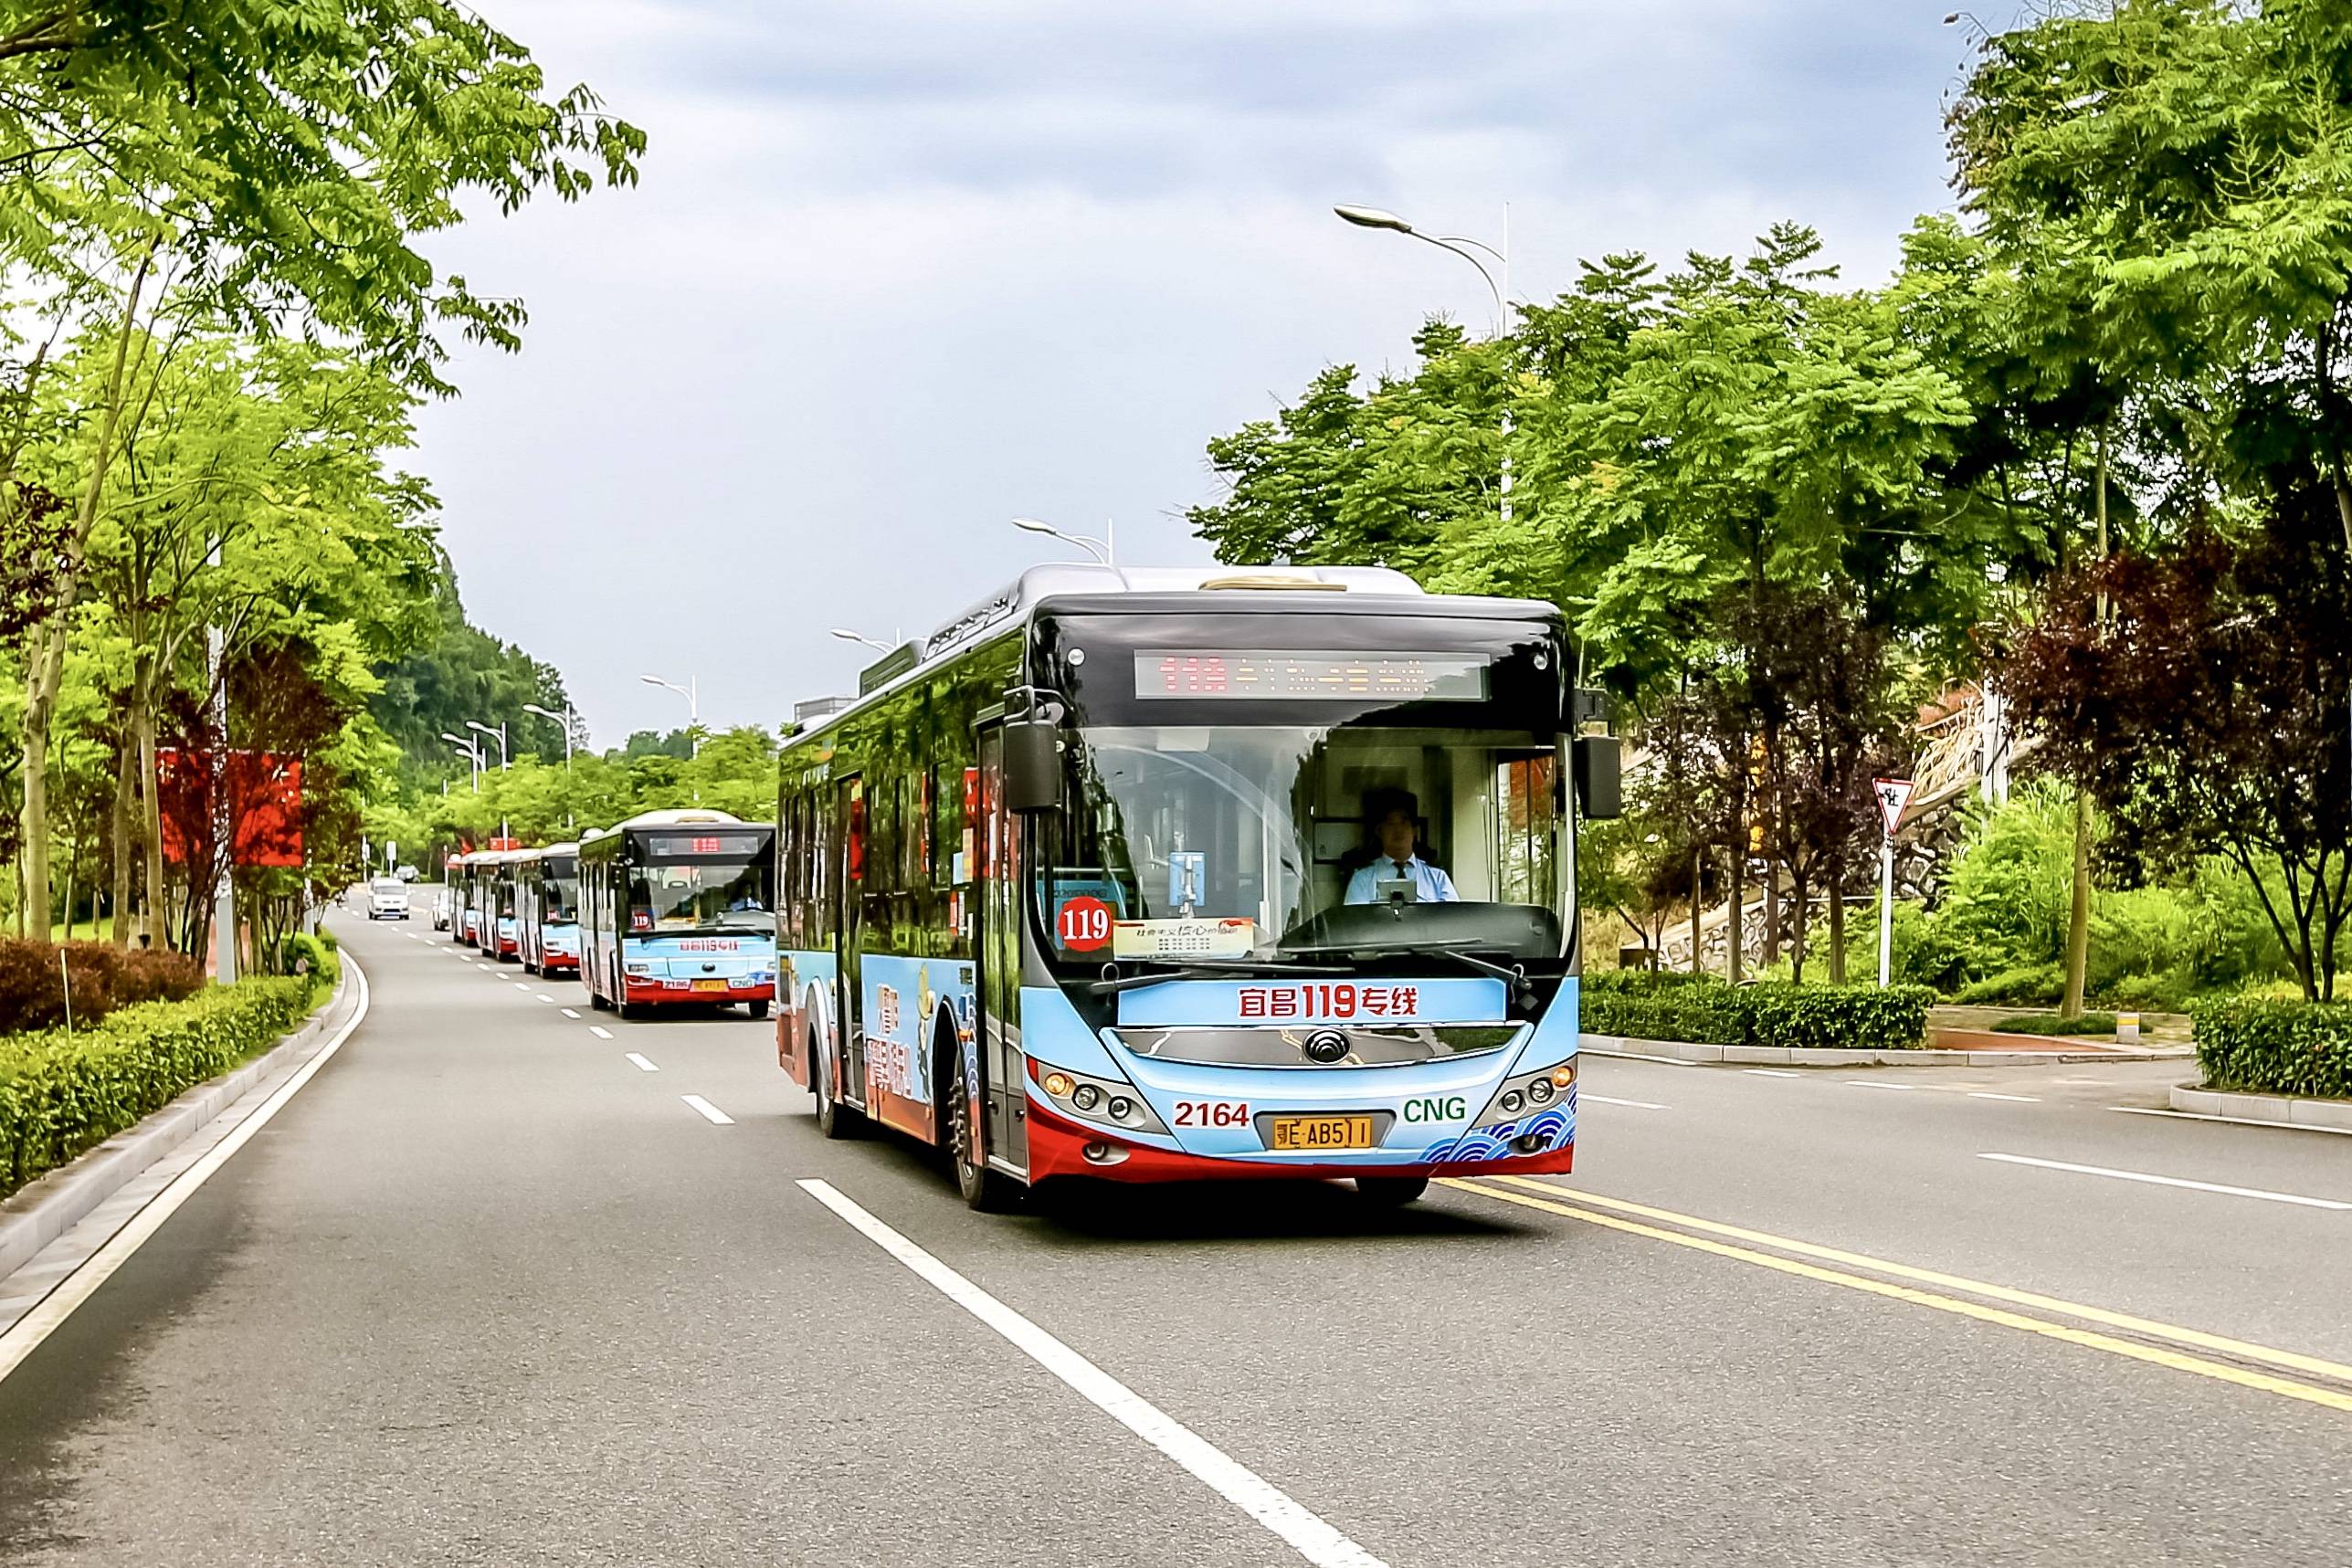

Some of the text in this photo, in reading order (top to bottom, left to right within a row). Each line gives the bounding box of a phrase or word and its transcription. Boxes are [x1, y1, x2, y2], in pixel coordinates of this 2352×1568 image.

[634, 916, 649, 926] 119
[1063, 909, 1109, 940] 119
[1239, 985, 1417, 1017] 宜昌119专线
[1175, 1102, 1249, 1127] 2164
[1403, 1097, 1465, 1123] CNG
